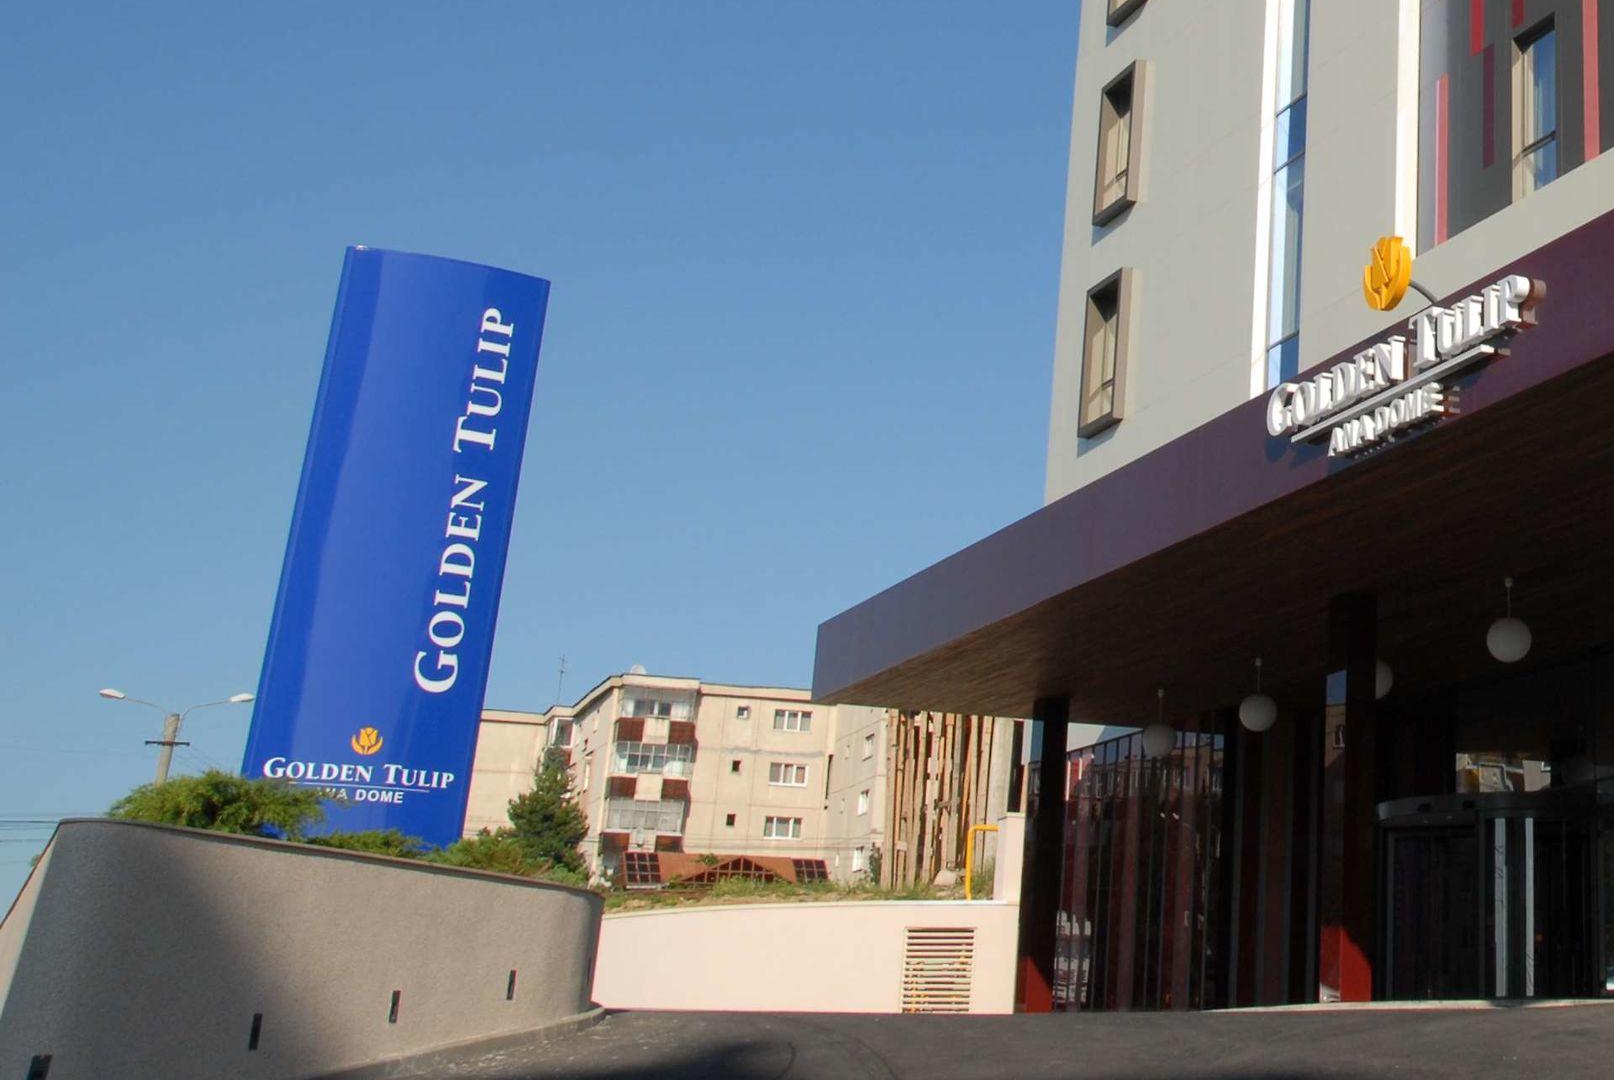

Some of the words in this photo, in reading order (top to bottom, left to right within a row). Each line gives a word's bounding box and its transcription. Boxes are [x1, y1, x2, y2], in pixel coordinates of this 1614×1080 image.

[1267, 335, 1406, 436] GOLDEN
[1408, 274, 1530, 369] TULIP
[1328, 414, 1376, 457] ANA
[1374, 381, 1445, 436] DOME
[414, 474, 488, 694] GOLDEN
[453, 307, 515, 453] TULIP
[263, 757, 374, 783] GOLDEN
[383, 763, 455, 789] TULIP
[355, 788, 404, 804] DOME
